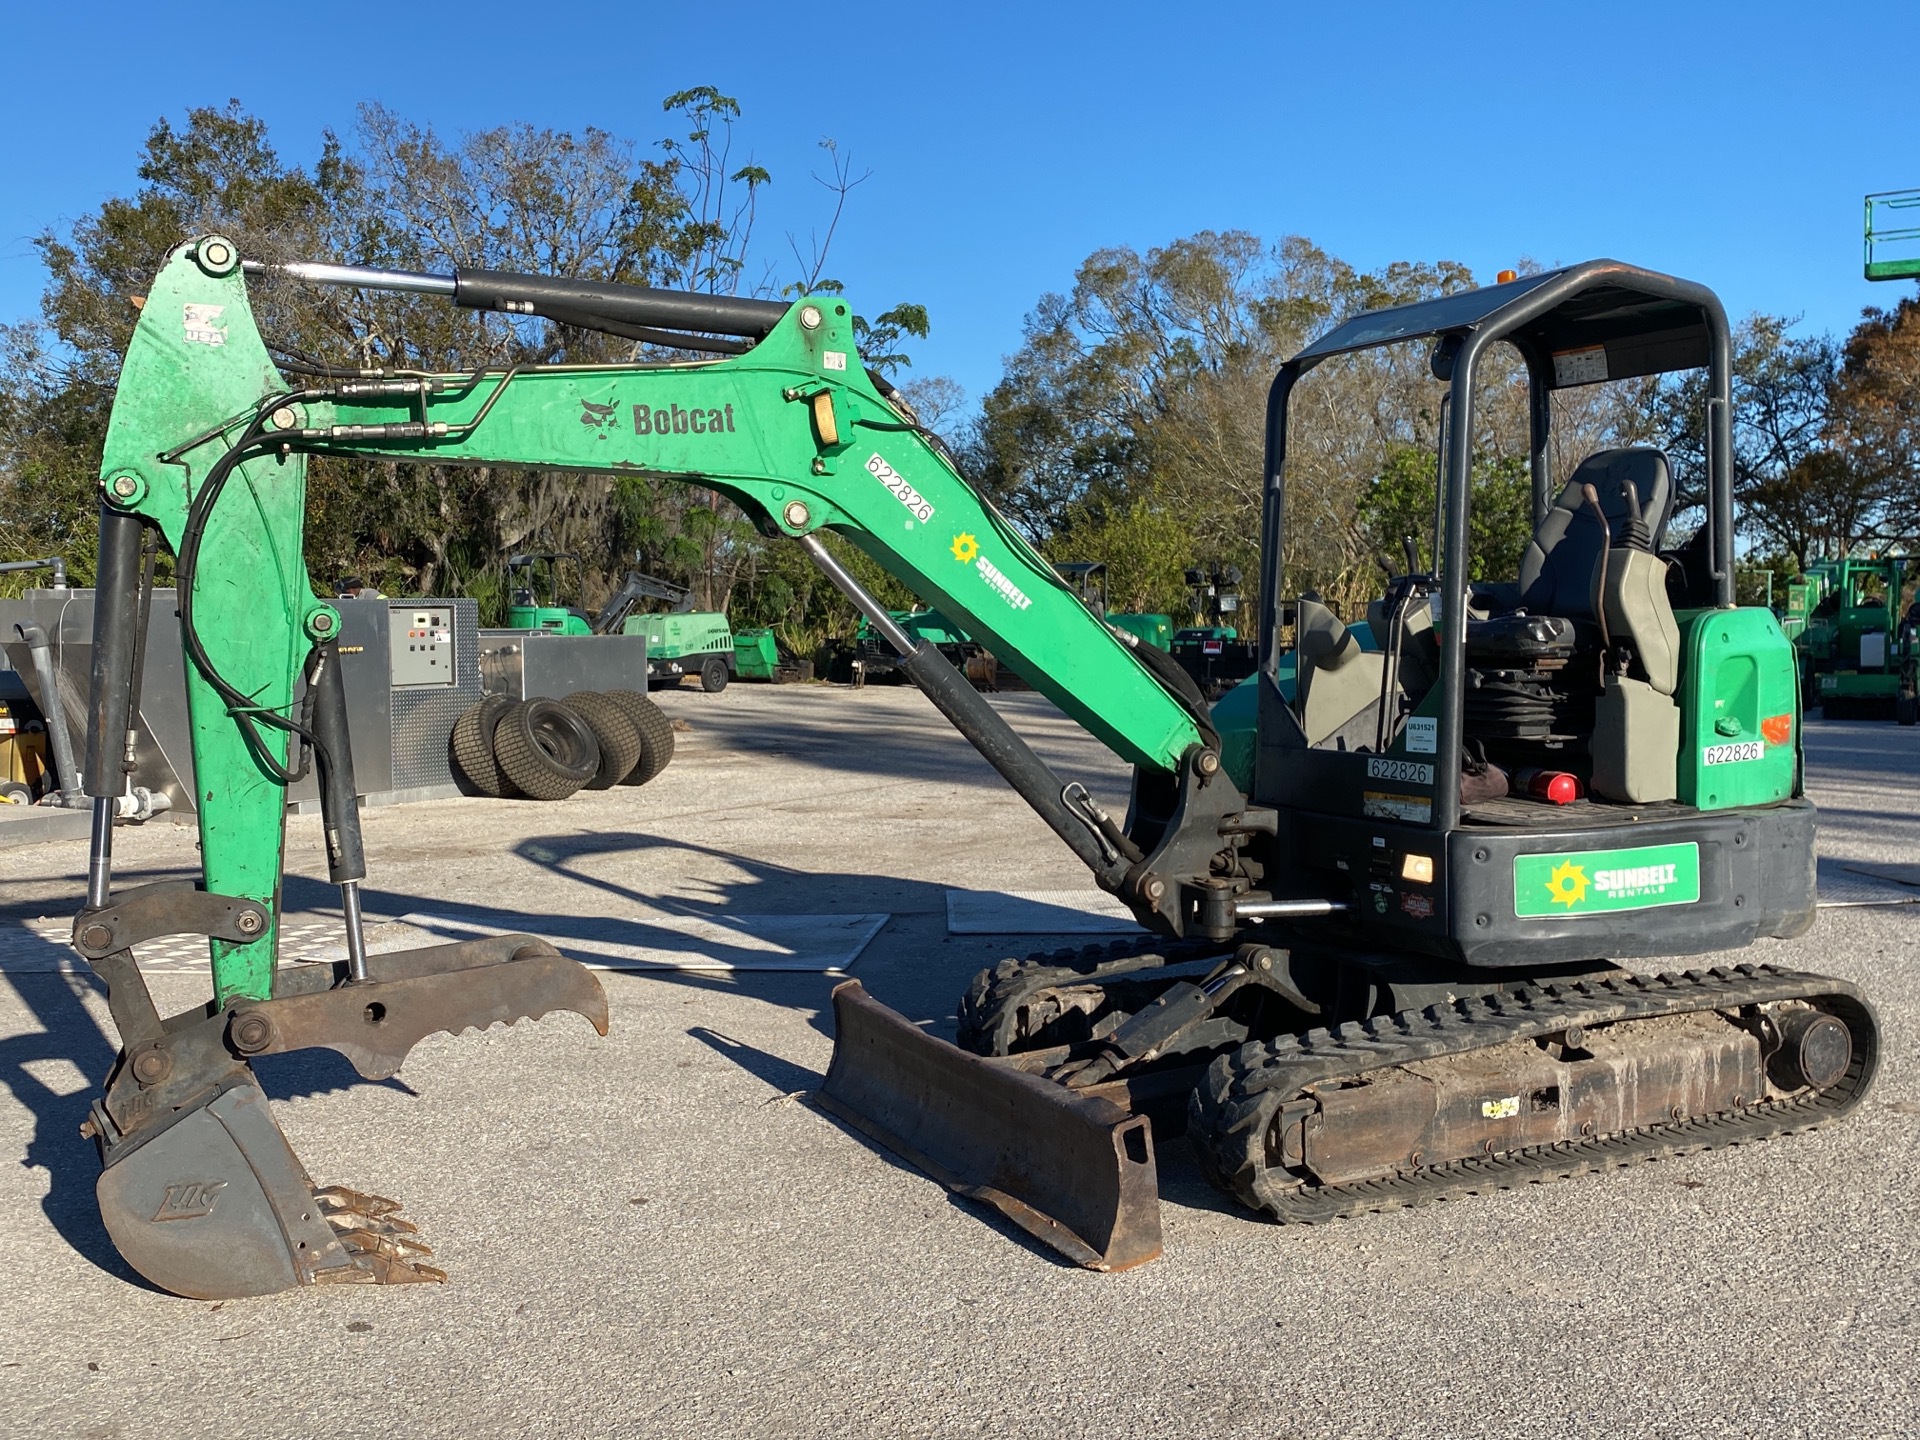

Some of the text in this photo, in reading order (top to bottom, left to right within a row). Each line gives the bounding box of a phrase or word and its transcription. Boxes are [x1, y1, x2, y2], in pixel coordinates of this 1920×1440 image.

[185, 329, 225, 344] USA
[632, 403, 736, 436] Bobcat
[868, 456, 932, 521] 622826
[975, 555, 1033, 611] SUNBELT
[1408, 723, 1435, 732] U631521
[1707, 742, 1758, 765] 622826
[1372, 759, 1427, 783] 622826
[1594, 864, 1676, 891] SUNBELT
[1608, 884, 1666, 899] RENTALS
